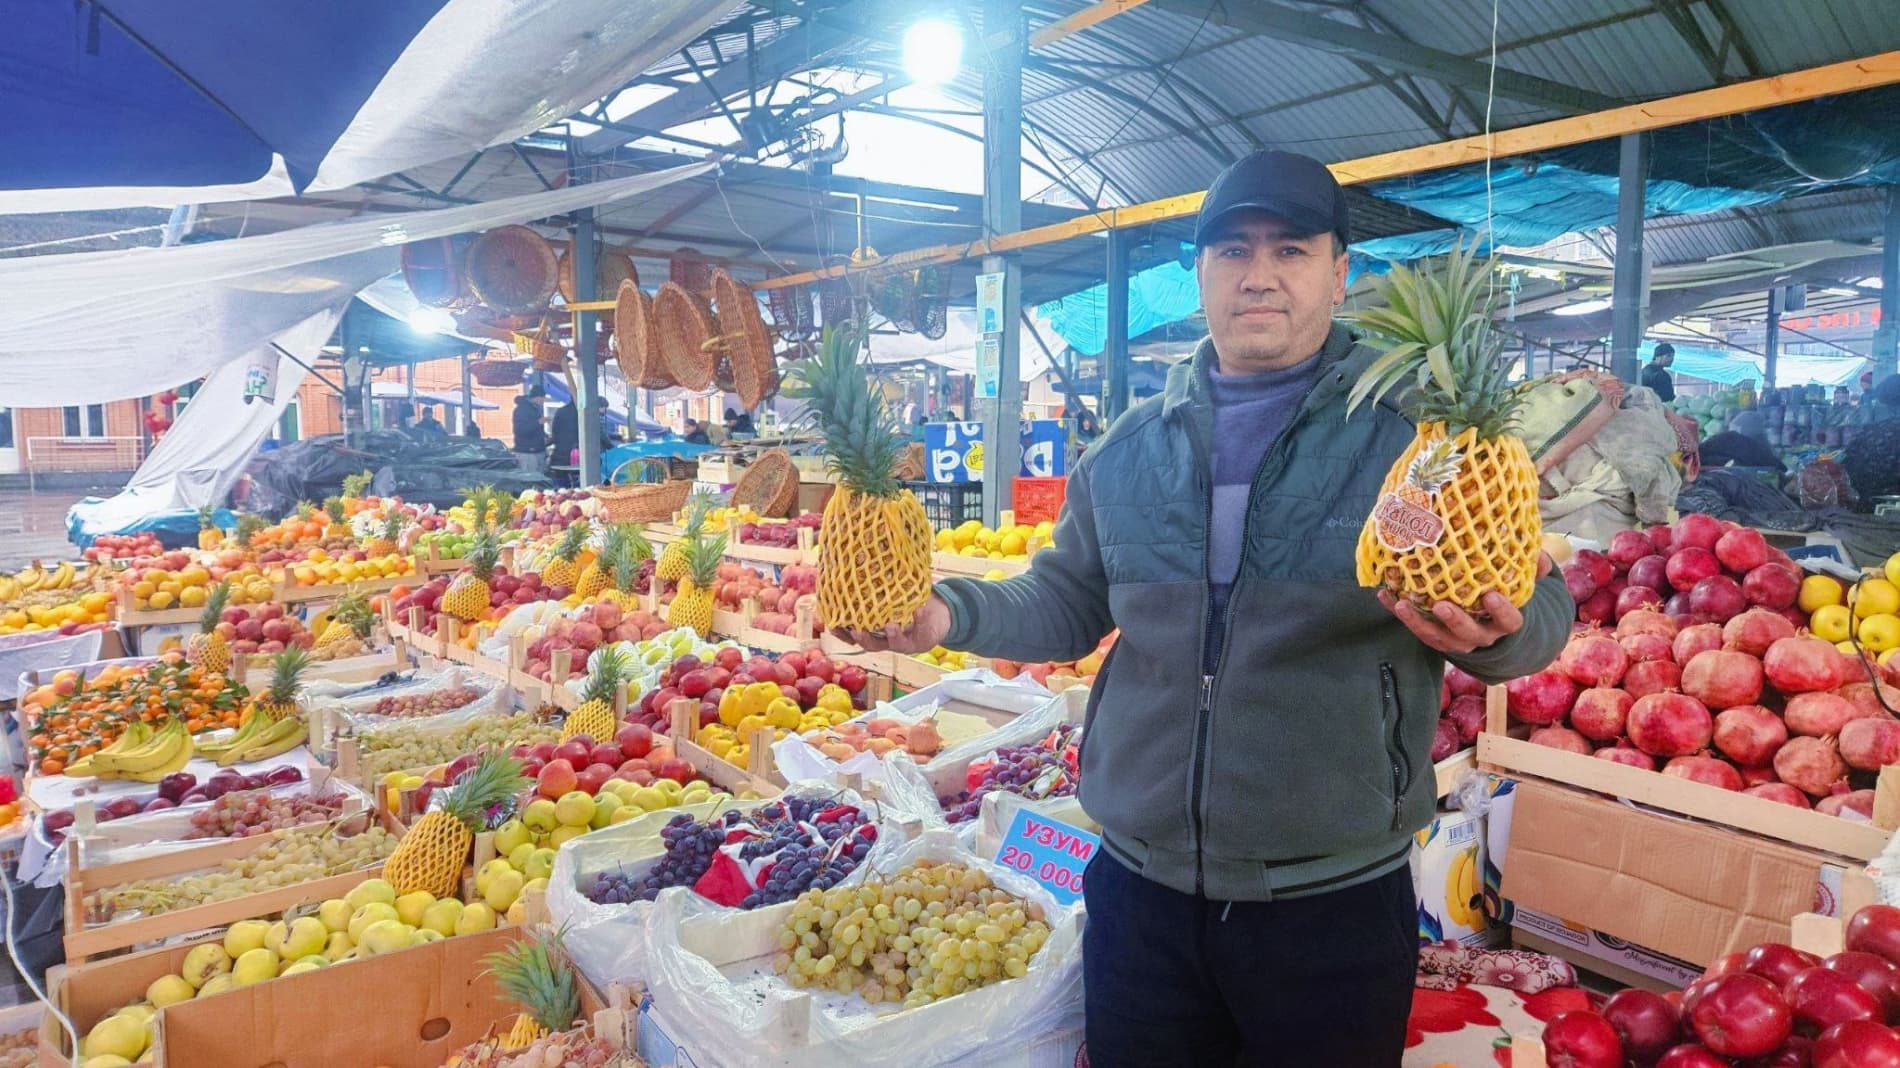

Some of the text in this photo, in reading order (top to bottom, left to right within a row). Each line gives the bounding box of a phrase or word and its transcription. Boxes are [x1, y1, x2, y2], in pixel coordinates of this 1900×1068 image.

[1022, 819, 1093, 860] УЗУМ
[1001, 846, 1083, 893] 20.000
[1518, 913, 1546, 929] PRODUCT
